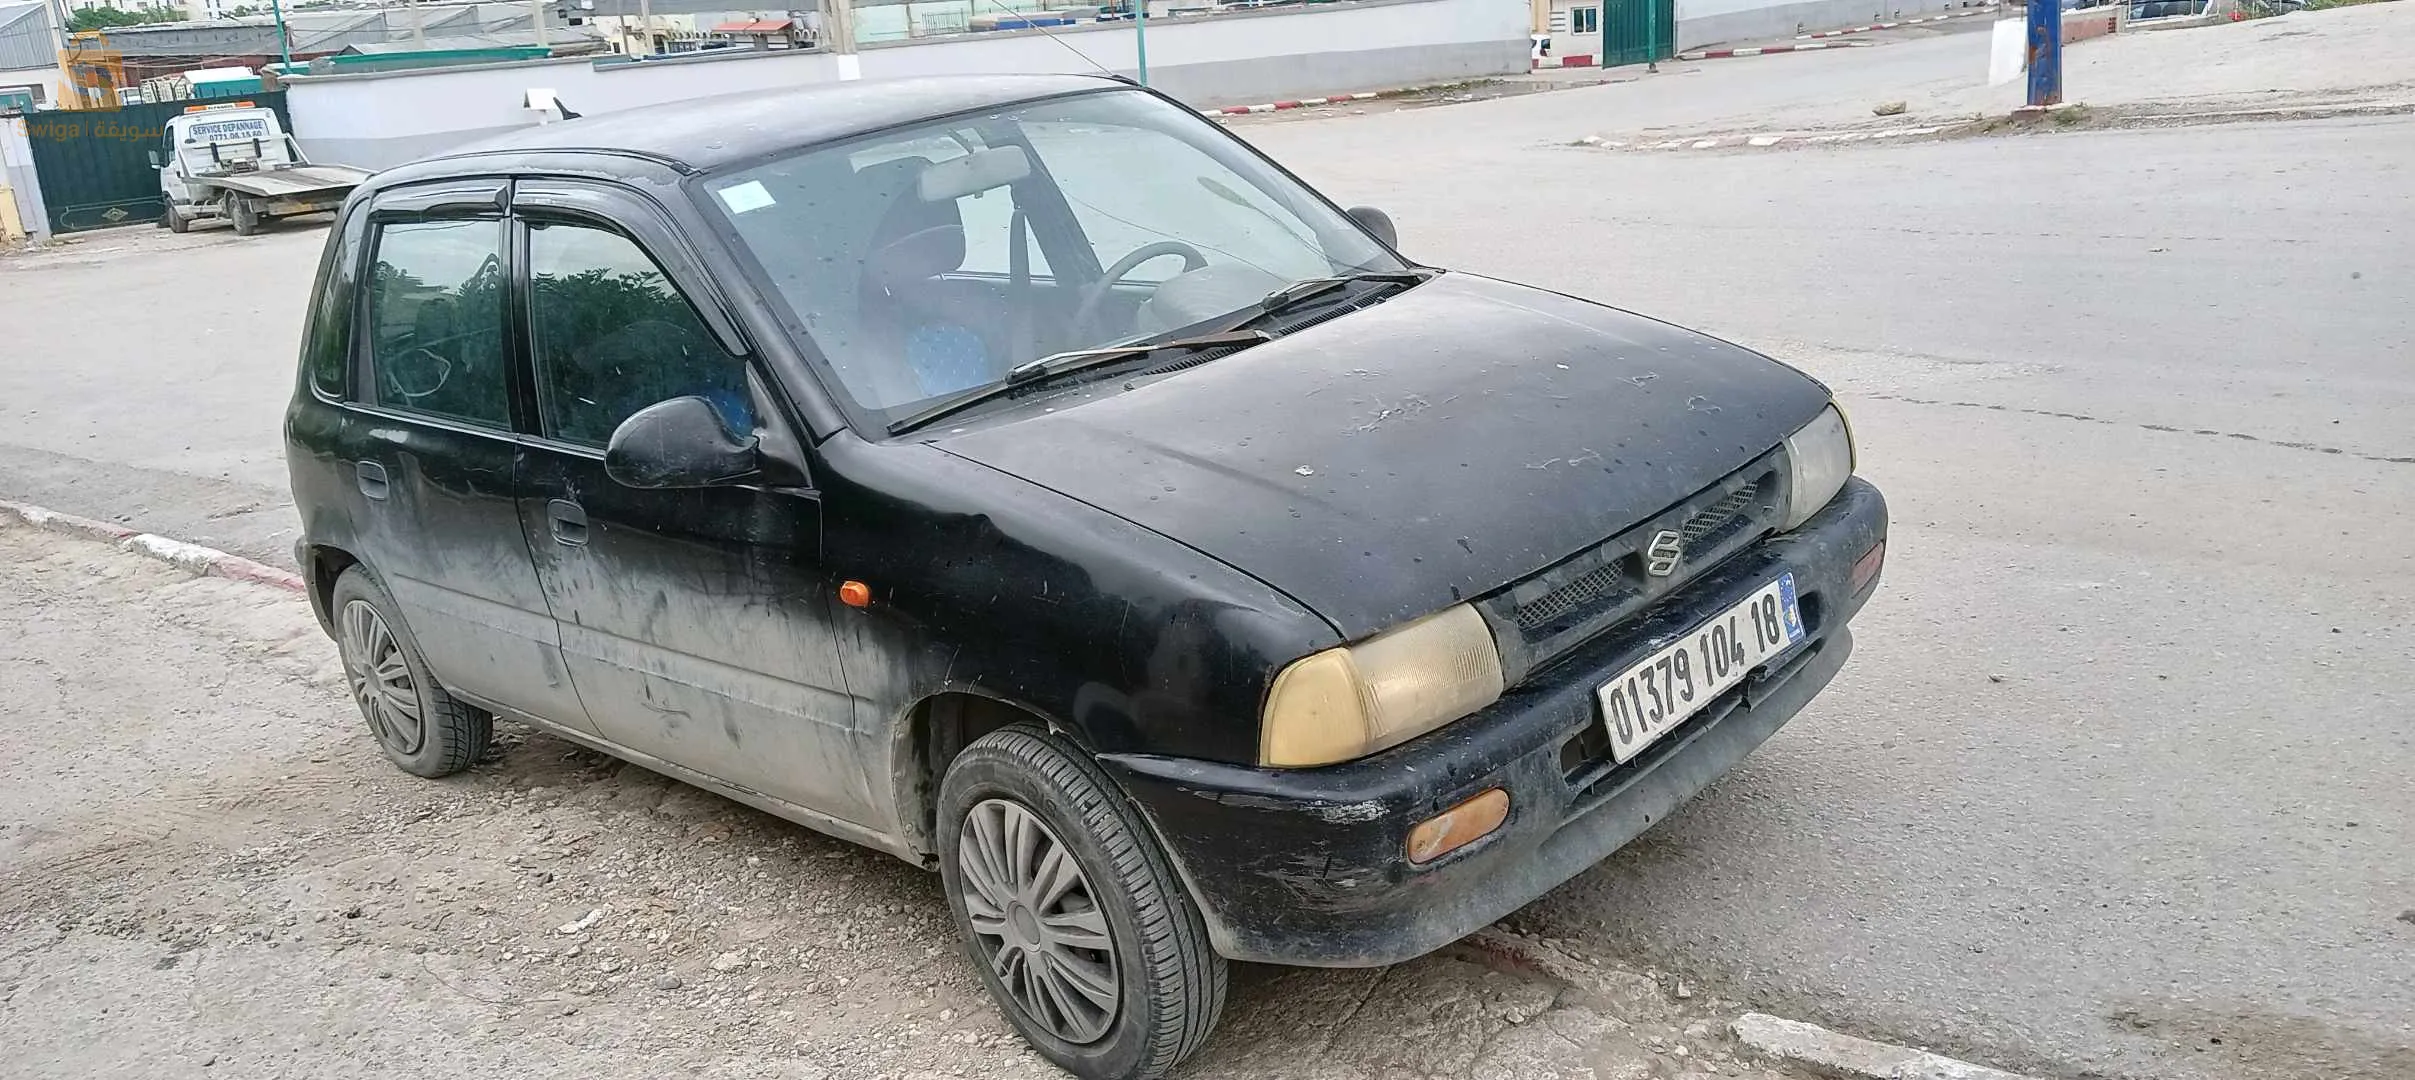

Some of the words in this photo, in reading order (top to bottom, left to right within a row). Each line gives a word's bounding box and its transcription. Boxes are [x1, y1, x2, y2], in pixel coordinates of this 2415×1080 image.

[193, 124, 222, 135] SERVICE
[1610, 648, 1694, 745] 01379
[1699, 615, 1745, 687] 104
[1751, 593, 1780, 653] 18
